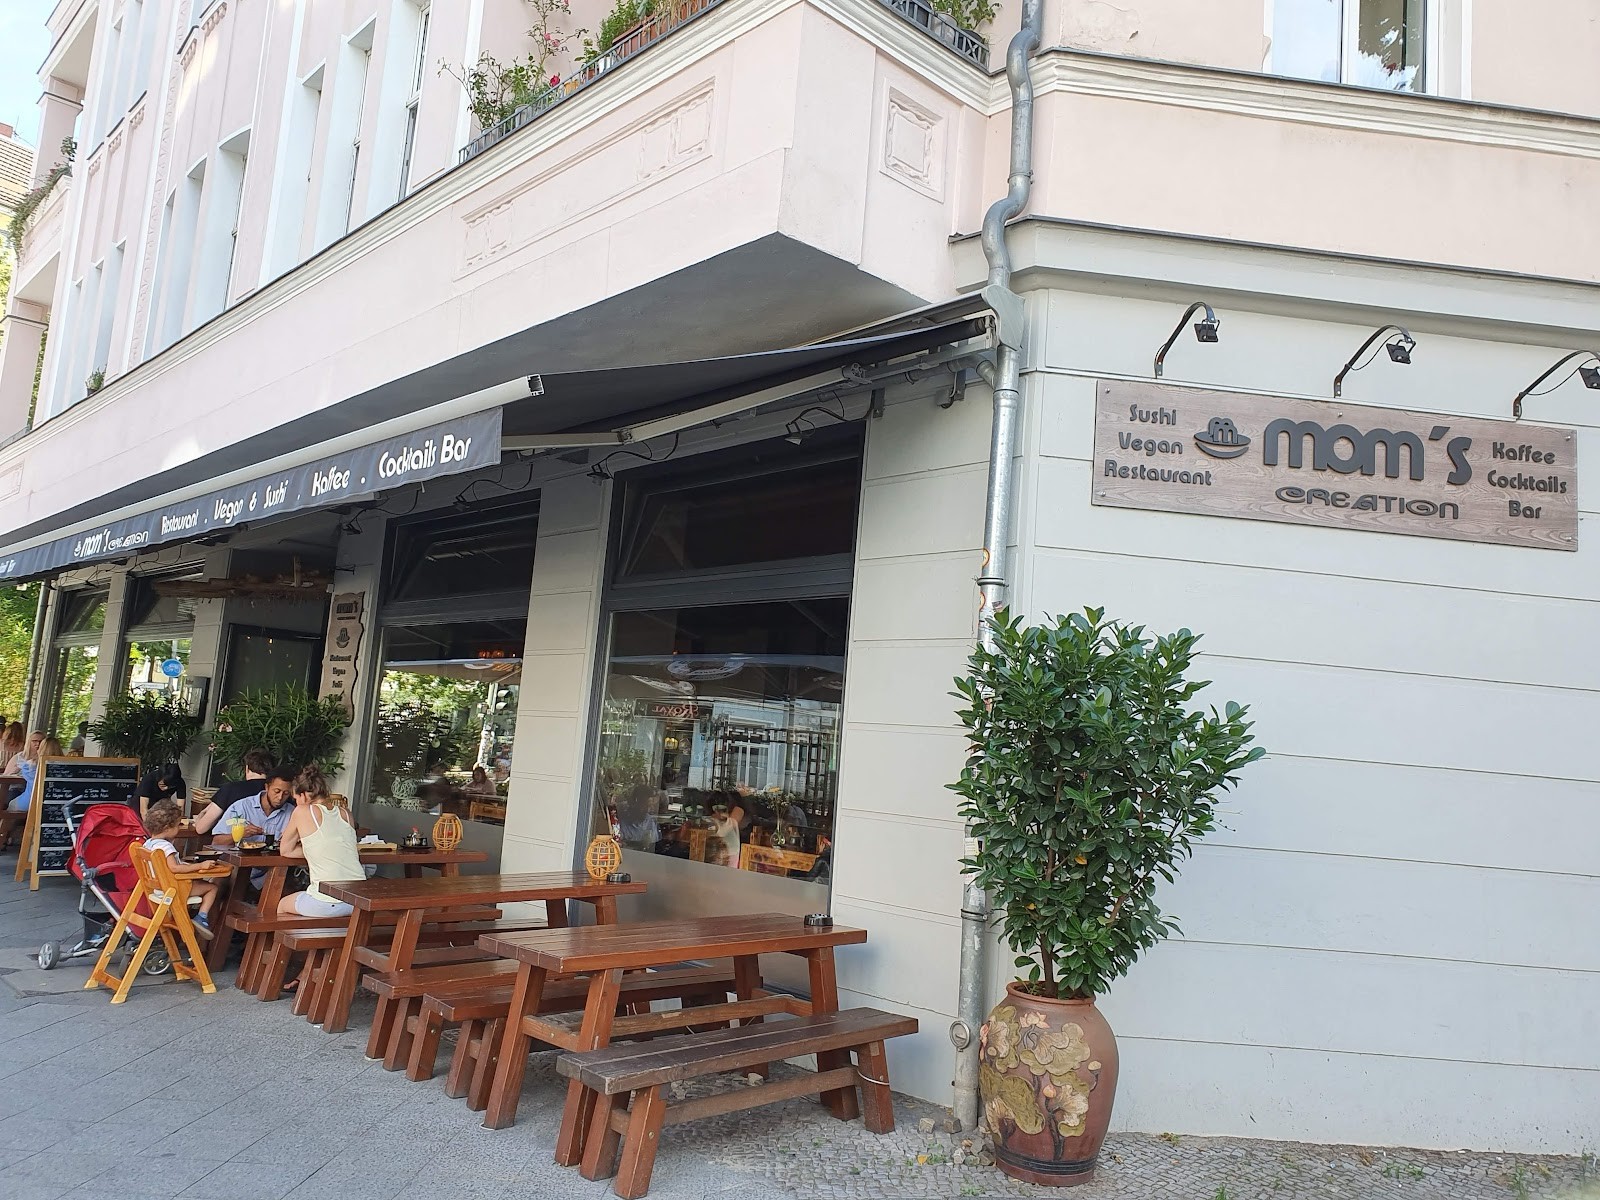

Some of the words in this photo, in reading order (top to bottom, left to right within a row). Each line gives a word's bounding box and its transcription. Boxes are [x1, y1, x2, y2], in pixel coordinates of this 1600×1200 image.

[1129, 403, 1177, 425] Sushi
[1118, 431, 1183, 456] Vegan
[1492, 441, 1556, 465] Kaffee
[161, 509, 199, 536] Restaurant
[213, 498, 244, 524] Vegan
[263, 479, 289, 509] Sushi
[311, 465, 351, 497] Kaffee
[378, 439, 437, 479] Cocktails
[440, 433, 472, 464] Bar
[1104, 459, 1212, 486] Restaurant
[1487, 469, 1567, 493] Cocktails
[1508, 499, 1542, 519] Bar
